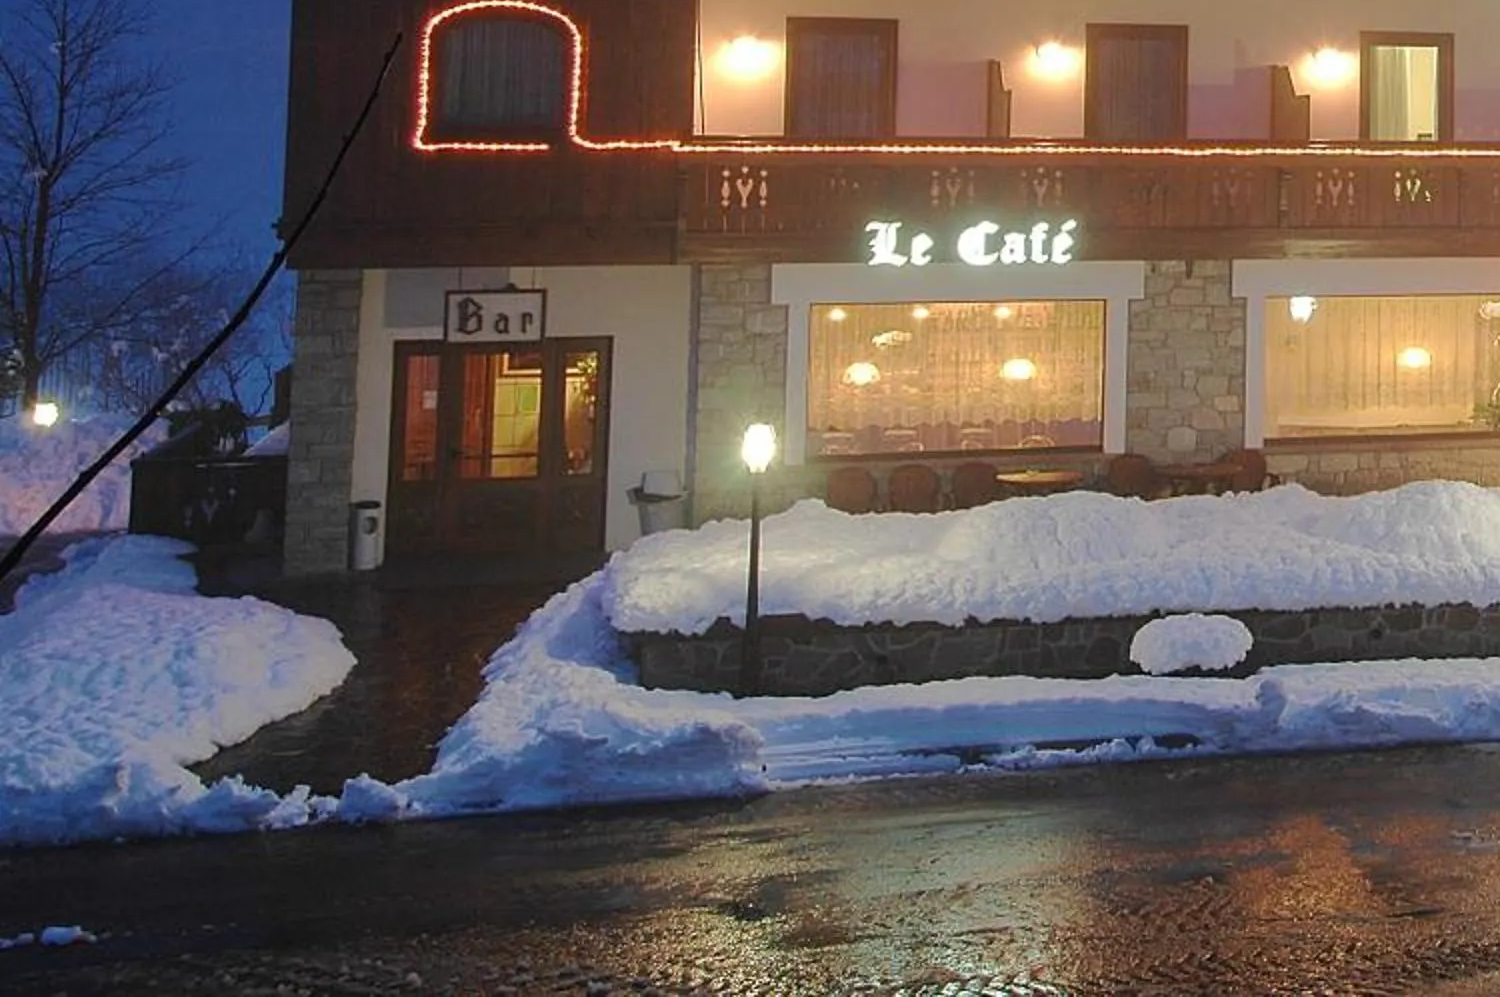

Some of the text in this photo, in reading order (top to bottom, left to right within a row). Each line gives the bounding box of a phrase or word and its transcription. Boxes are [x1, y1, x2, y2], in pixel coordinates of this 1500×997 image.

[865, 218, 1078, 266] Le Café
[456, 298, 533, 336] Bar
